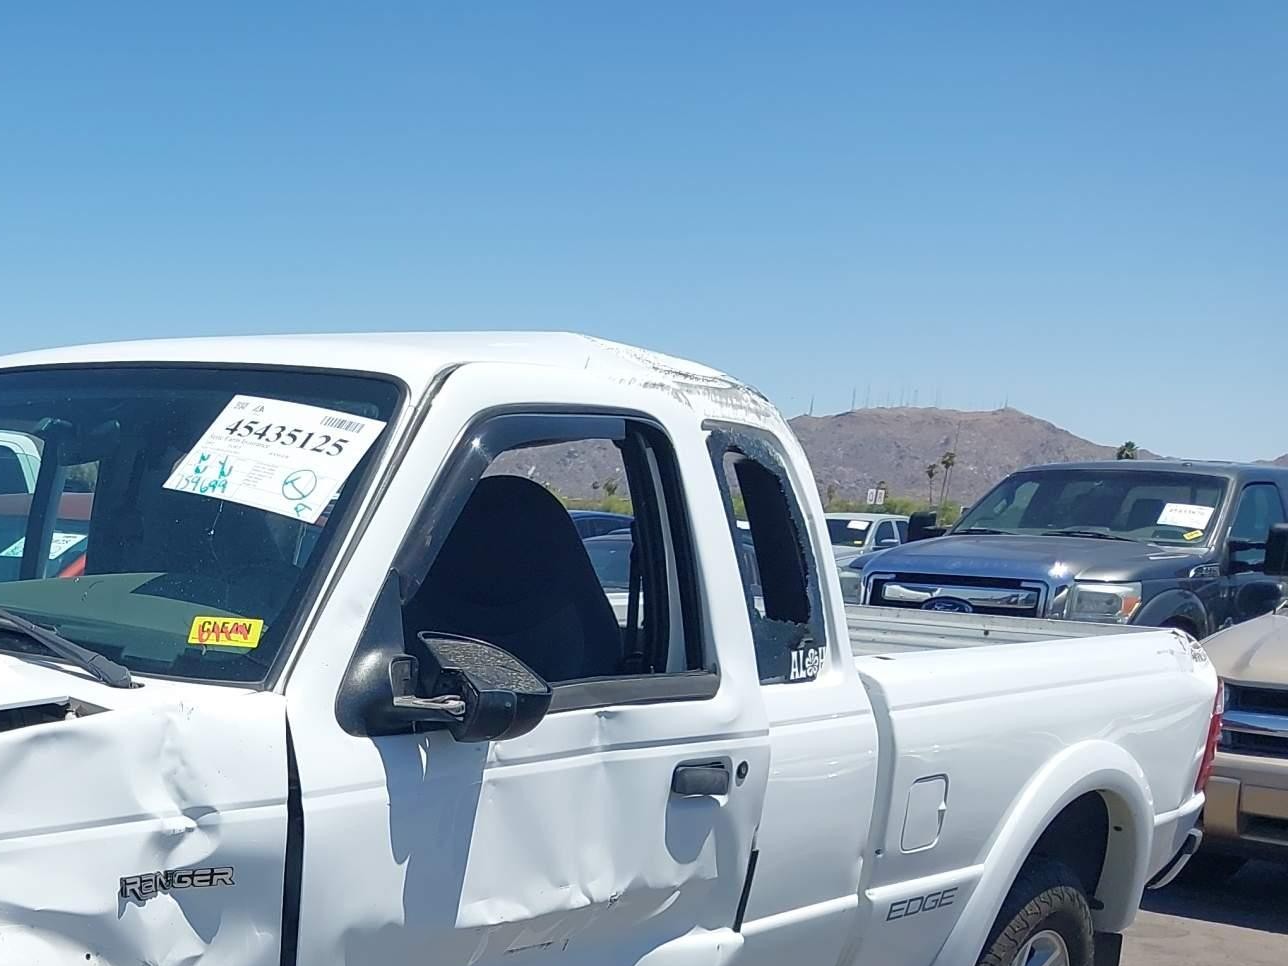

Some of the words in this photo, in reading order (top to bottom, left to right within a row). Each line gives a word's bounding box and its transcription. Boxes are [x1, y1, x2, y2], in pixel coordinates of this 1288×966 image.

[225, 419, 350, 456] 45435125
[119, 866, 236, 902] RANGER
[885, 886, 959, 922] EDGE
